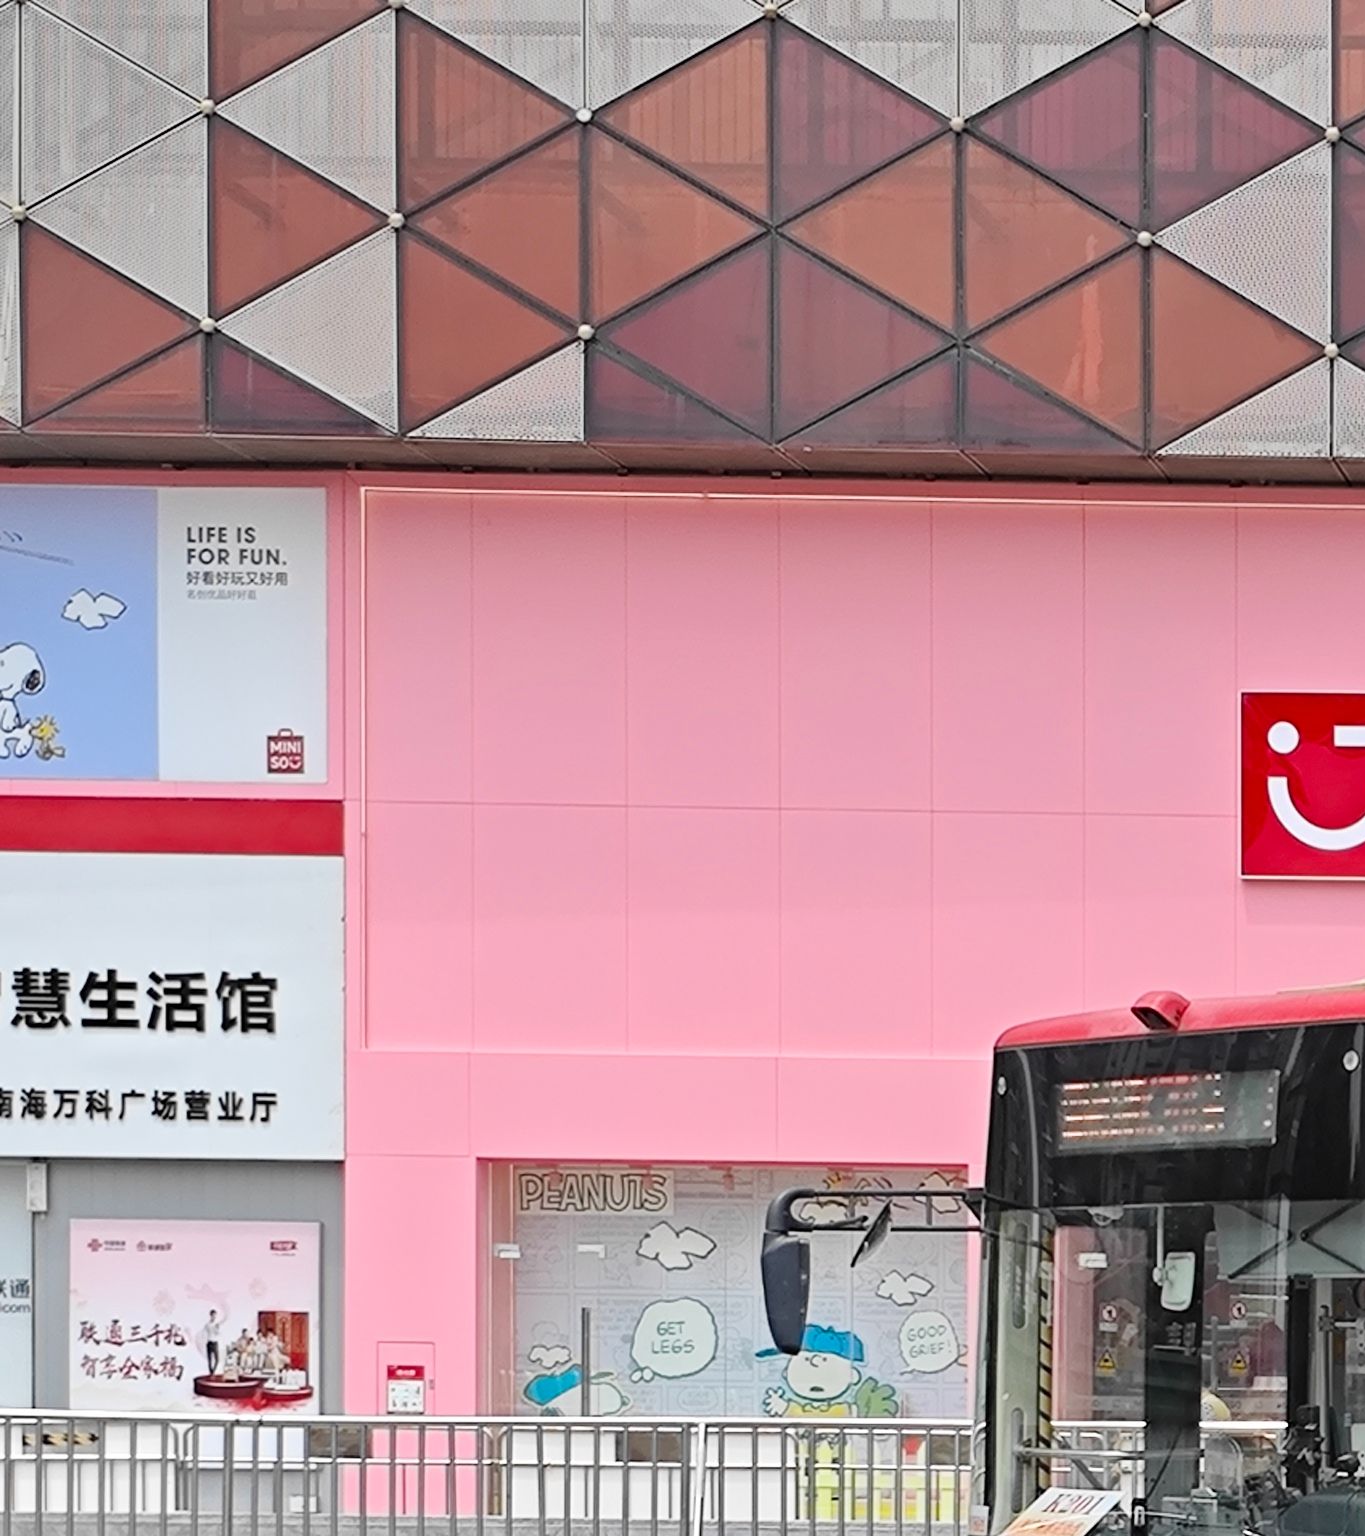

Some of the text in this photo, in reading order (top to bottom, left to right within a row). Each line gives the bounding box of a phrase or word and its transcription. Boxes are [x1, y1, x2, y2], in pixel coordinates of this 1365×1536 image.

[186, 526, 257, 543] LIFE IS
[186, 547, 288, 565] FOR FUN.
[186, 571, 289, 587] 好看好玩又好用
[270, 740, 302, 754] MINI
[0, 967, 279, 1033] 慧生活馆
[518, 1172, 669, 1213] PEANUTS
[656, 1321, 686, 1337] GET
[906, 1324, 948, 1342] GOOD
[651, 1339, 696, 1355] LEGS
[908, 1340, 953, 1359] GRIEF!
[1041, 1493, 1106, 1515] K201
